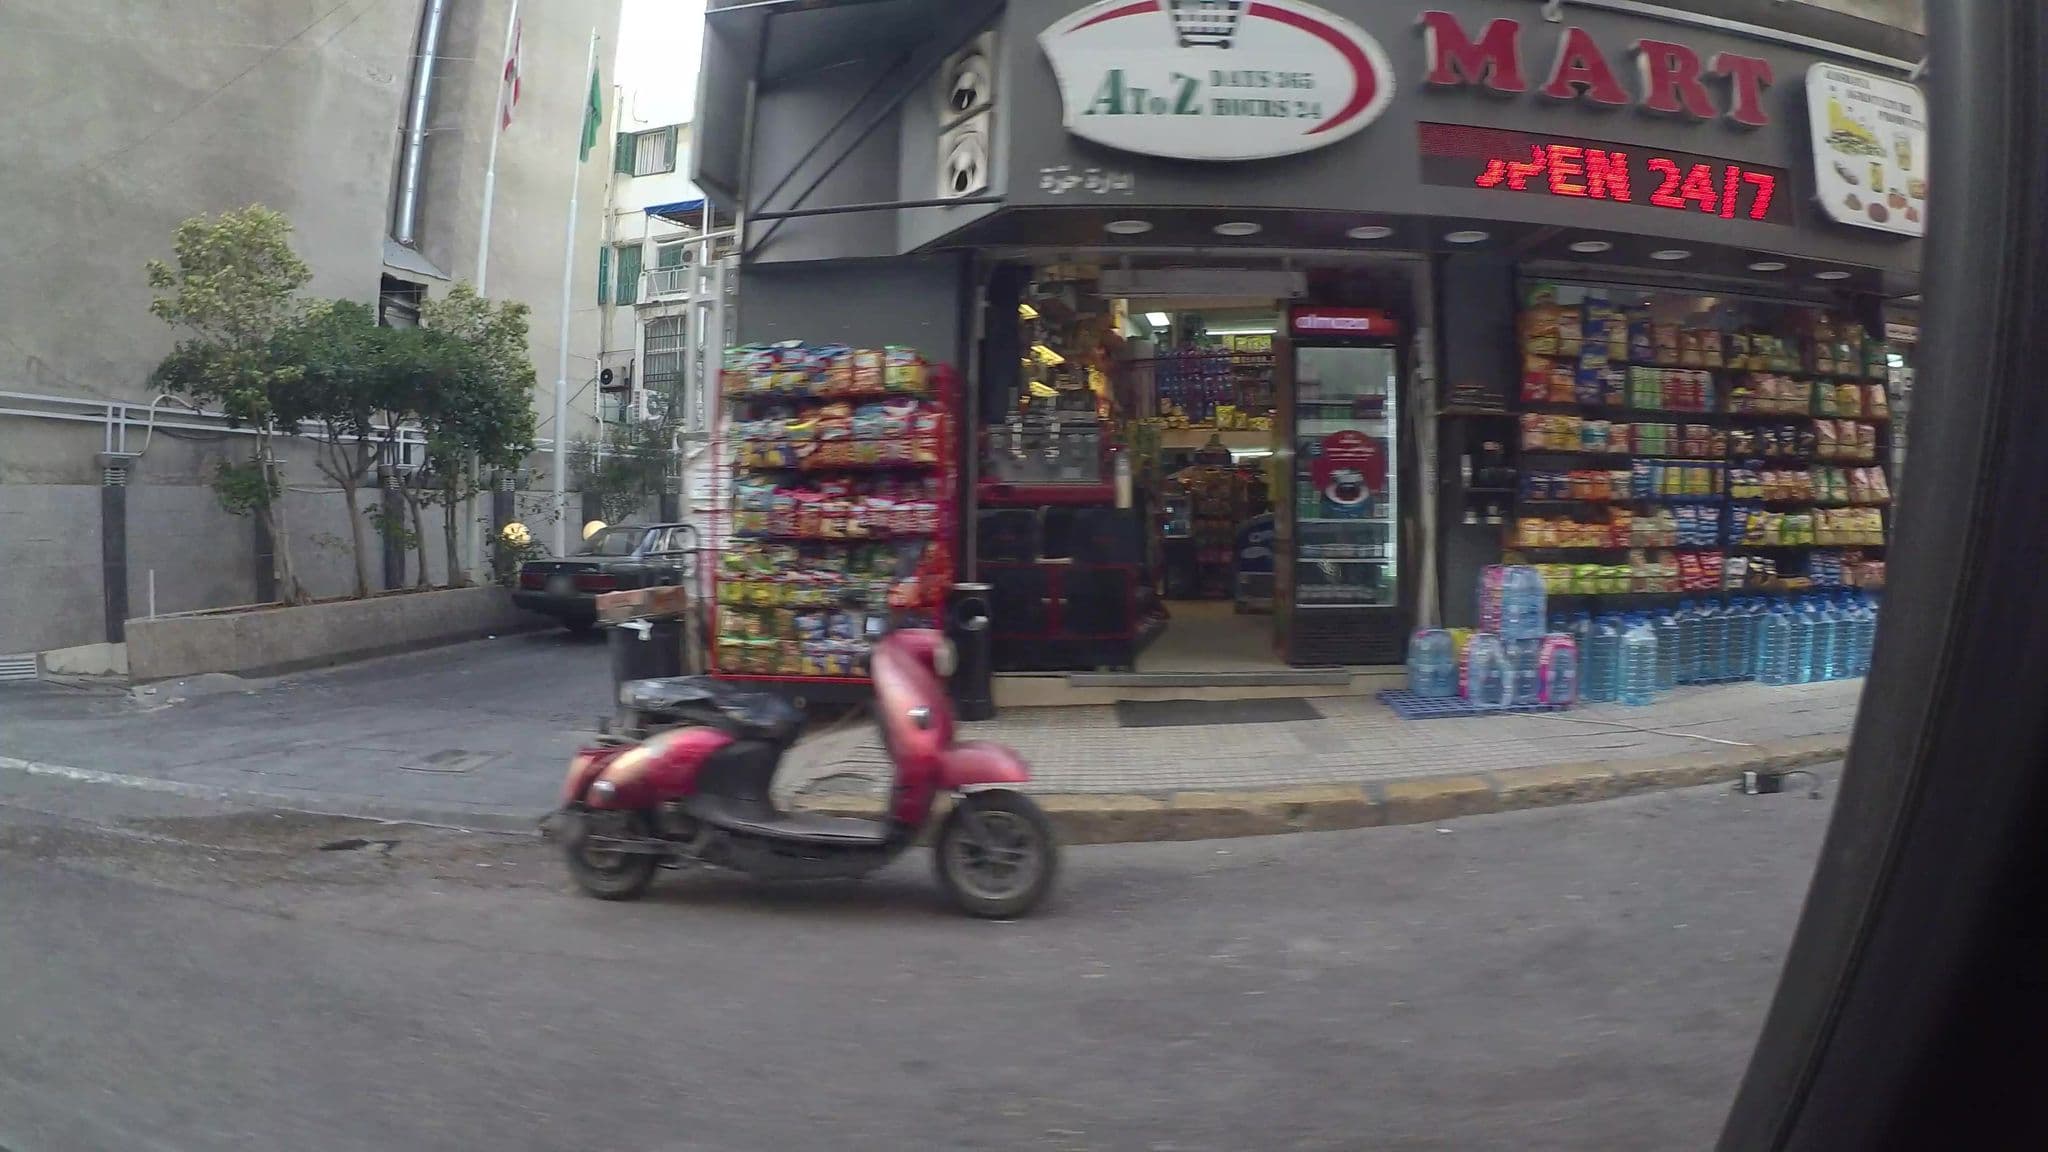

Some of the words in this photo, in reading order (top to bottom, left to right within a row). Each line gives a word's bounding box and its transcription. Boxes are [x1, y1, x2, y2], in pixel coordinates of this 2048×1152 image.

[1418, 9, 1775, 128] MART
[1211, 98, 1289, 119] HOURS
[1294, 100, 1323, 120] 24
